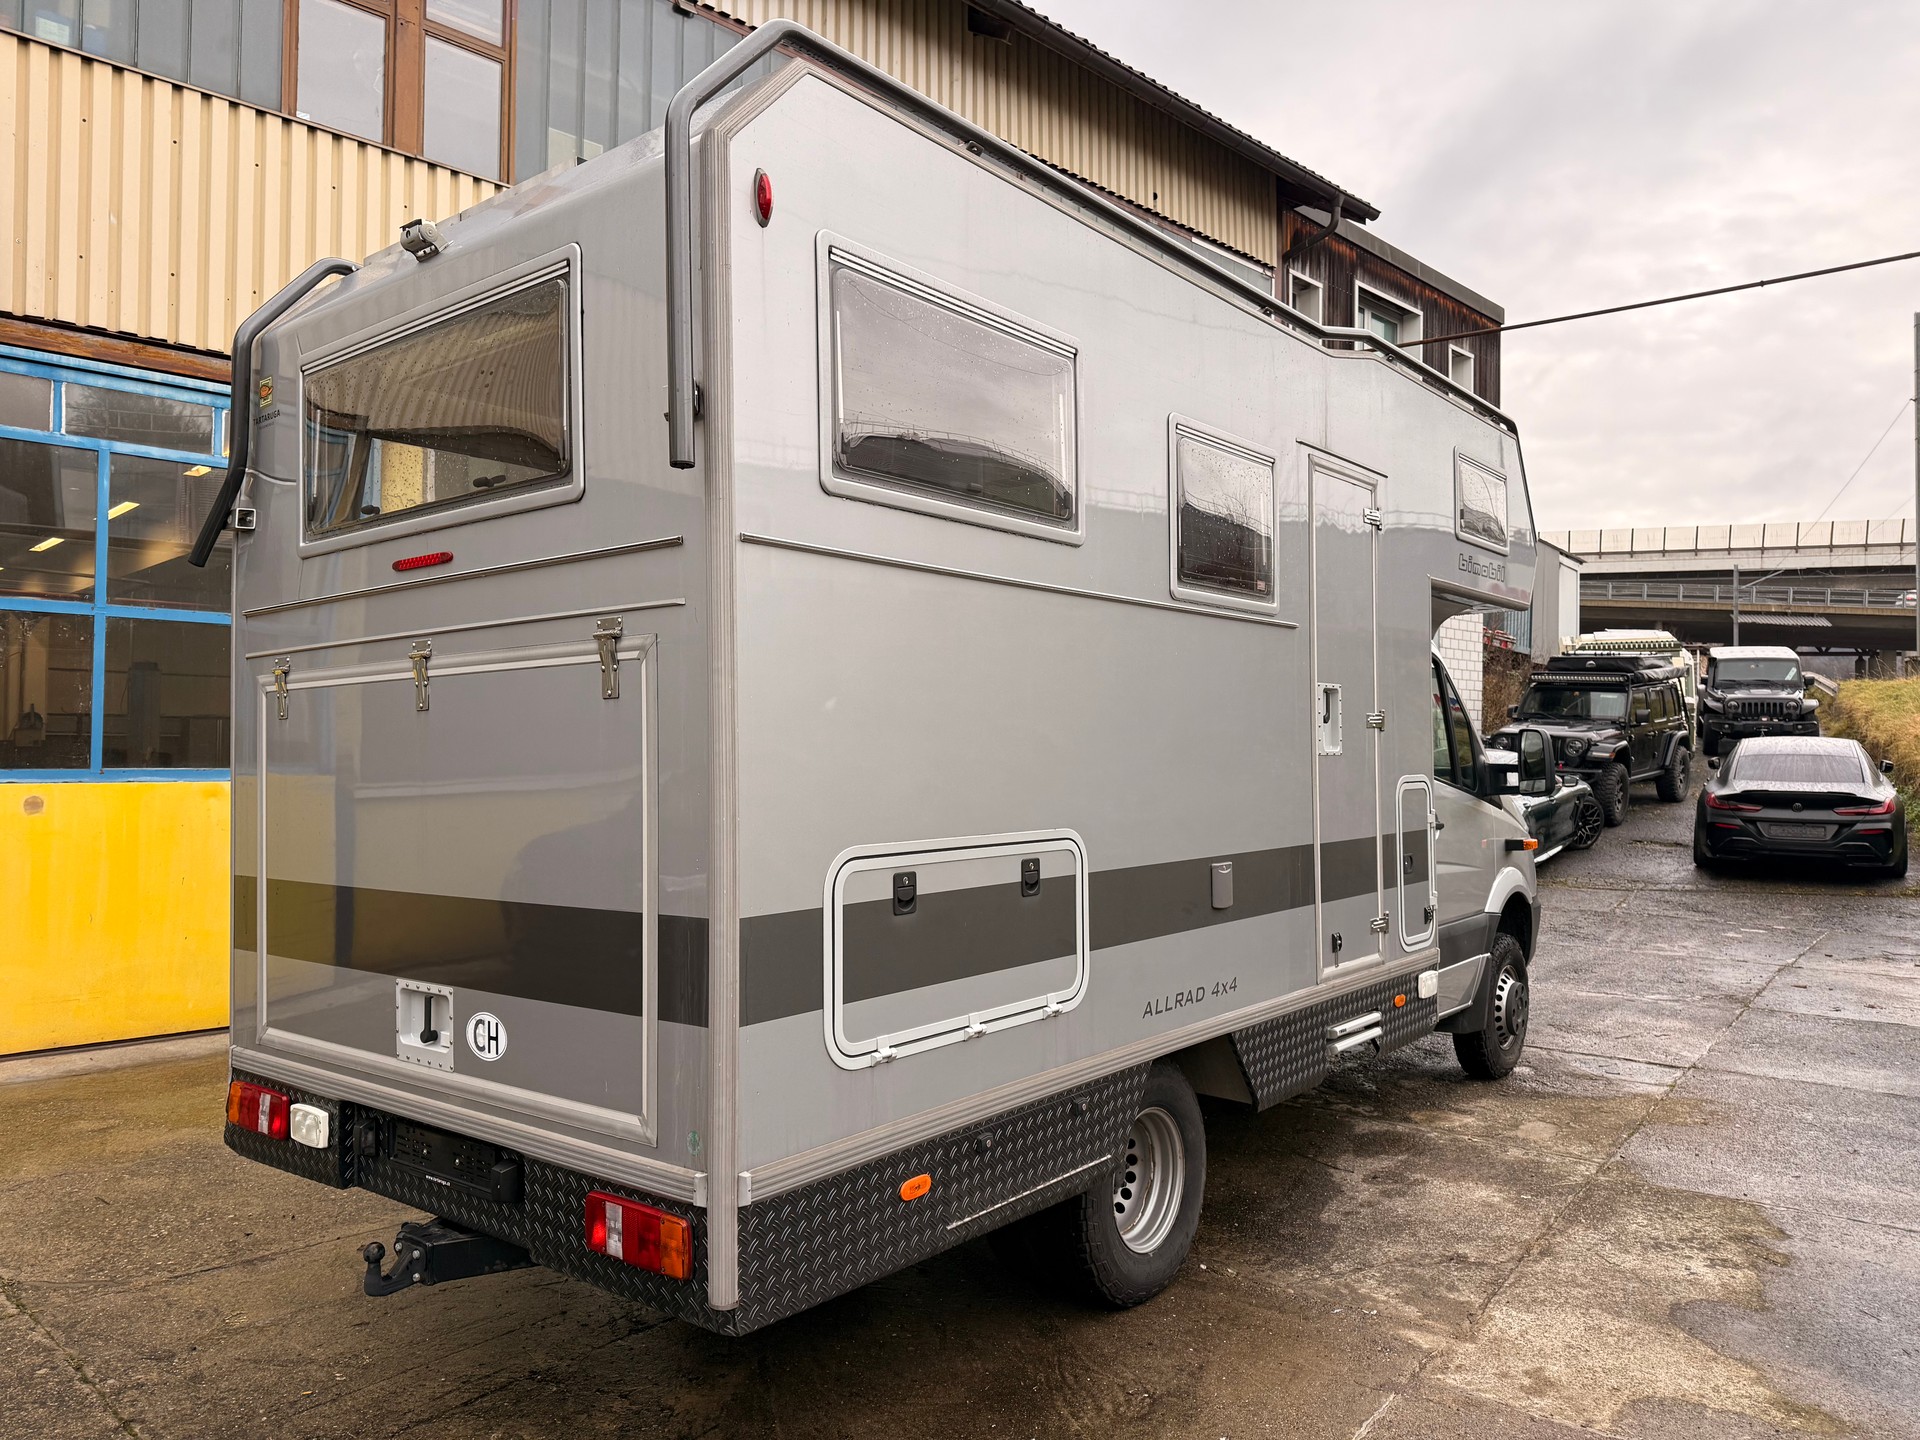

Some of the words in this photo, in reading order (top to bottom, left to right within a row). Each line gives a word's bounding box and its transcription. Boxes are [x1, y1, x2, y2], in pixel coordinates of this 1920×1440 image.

[253, 409, 281, 425] TARTARUGA
[1458, 553, 1505, 582] bimobil
[1142, 986, 1206, 1019] ALLRAD
[1211, 976, 1238, 997] 4x4
[473, 1018, 499, 1056] CH
